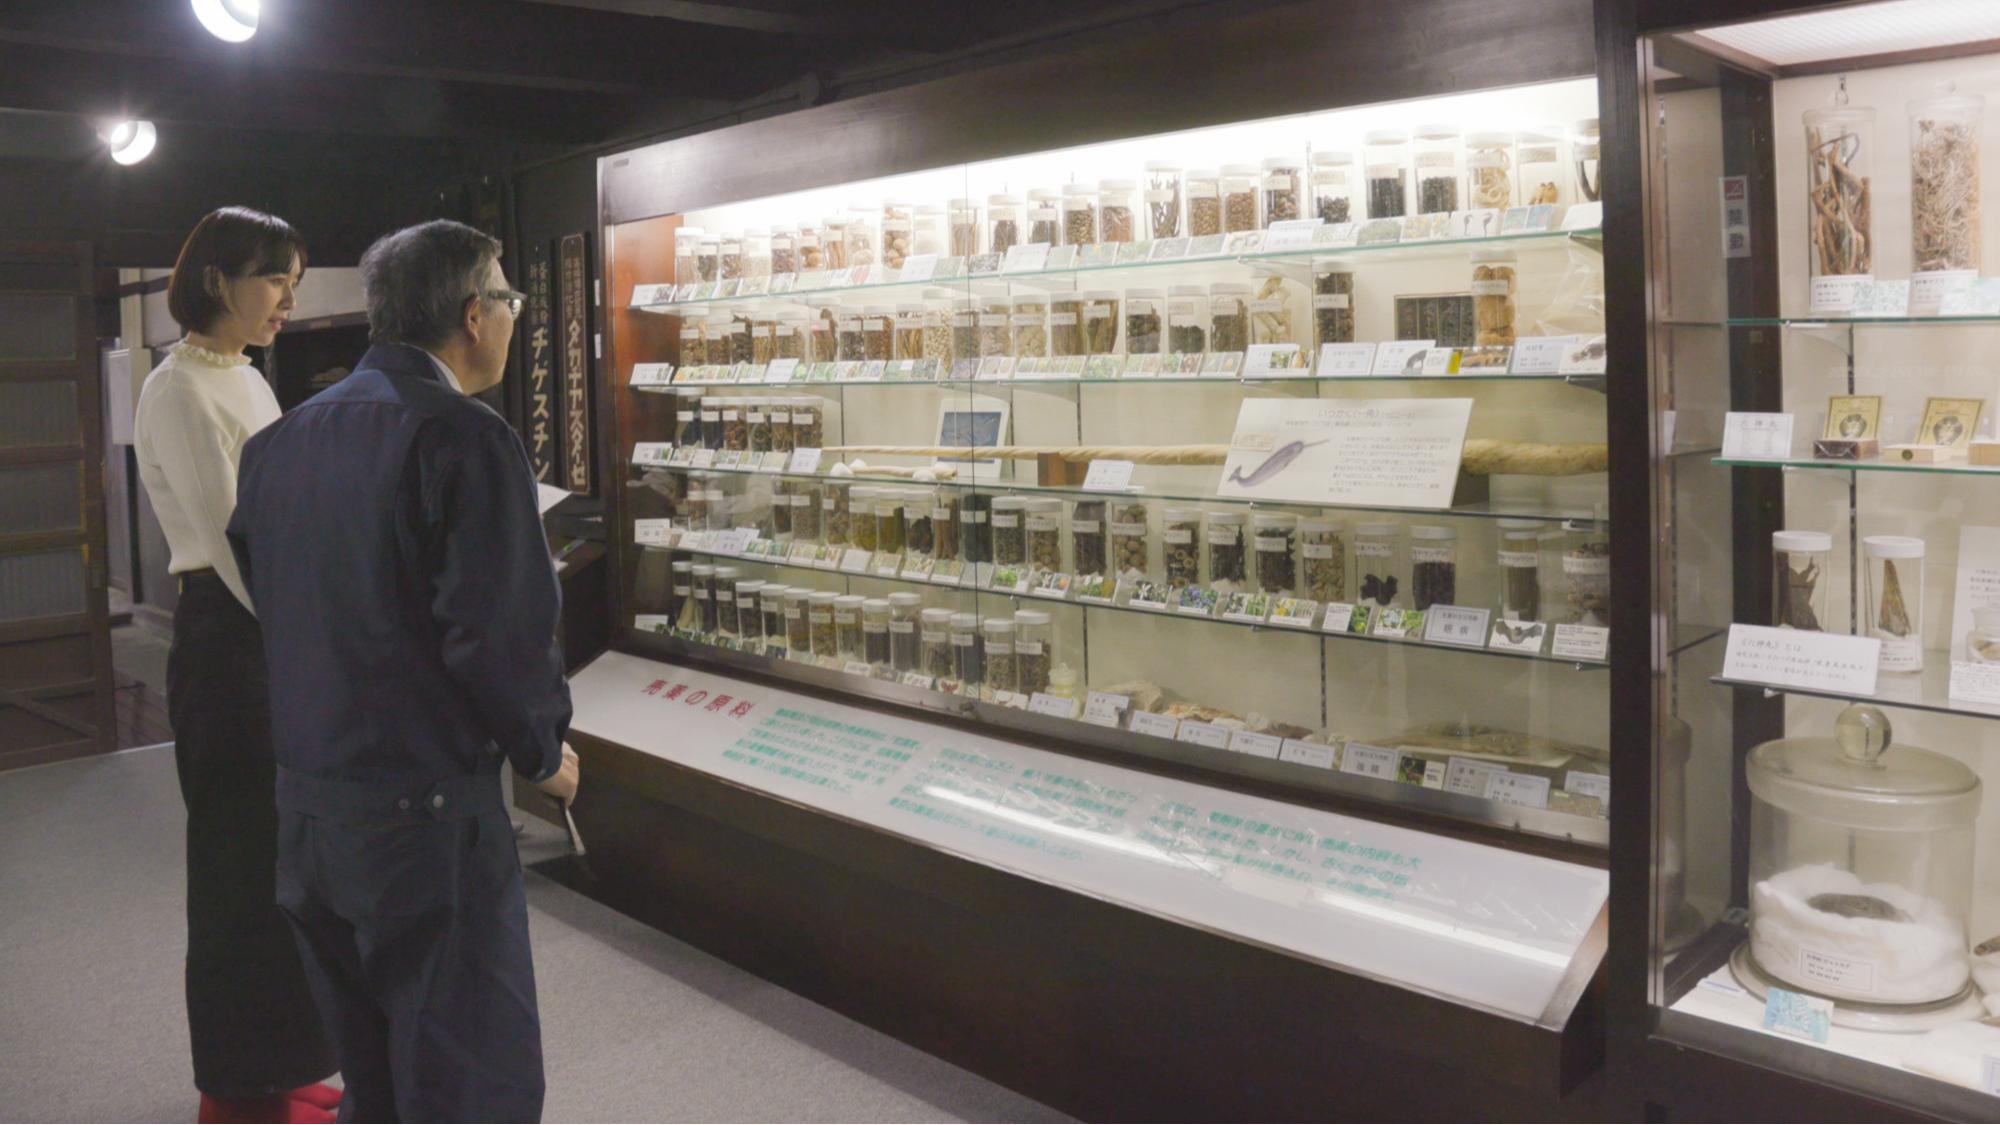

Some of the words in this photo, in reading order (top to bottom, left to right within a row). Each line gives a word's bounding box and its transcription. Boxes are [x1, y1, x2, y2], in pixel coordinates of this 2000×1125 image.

[641, 679, 757, 718] 売薬の原料
